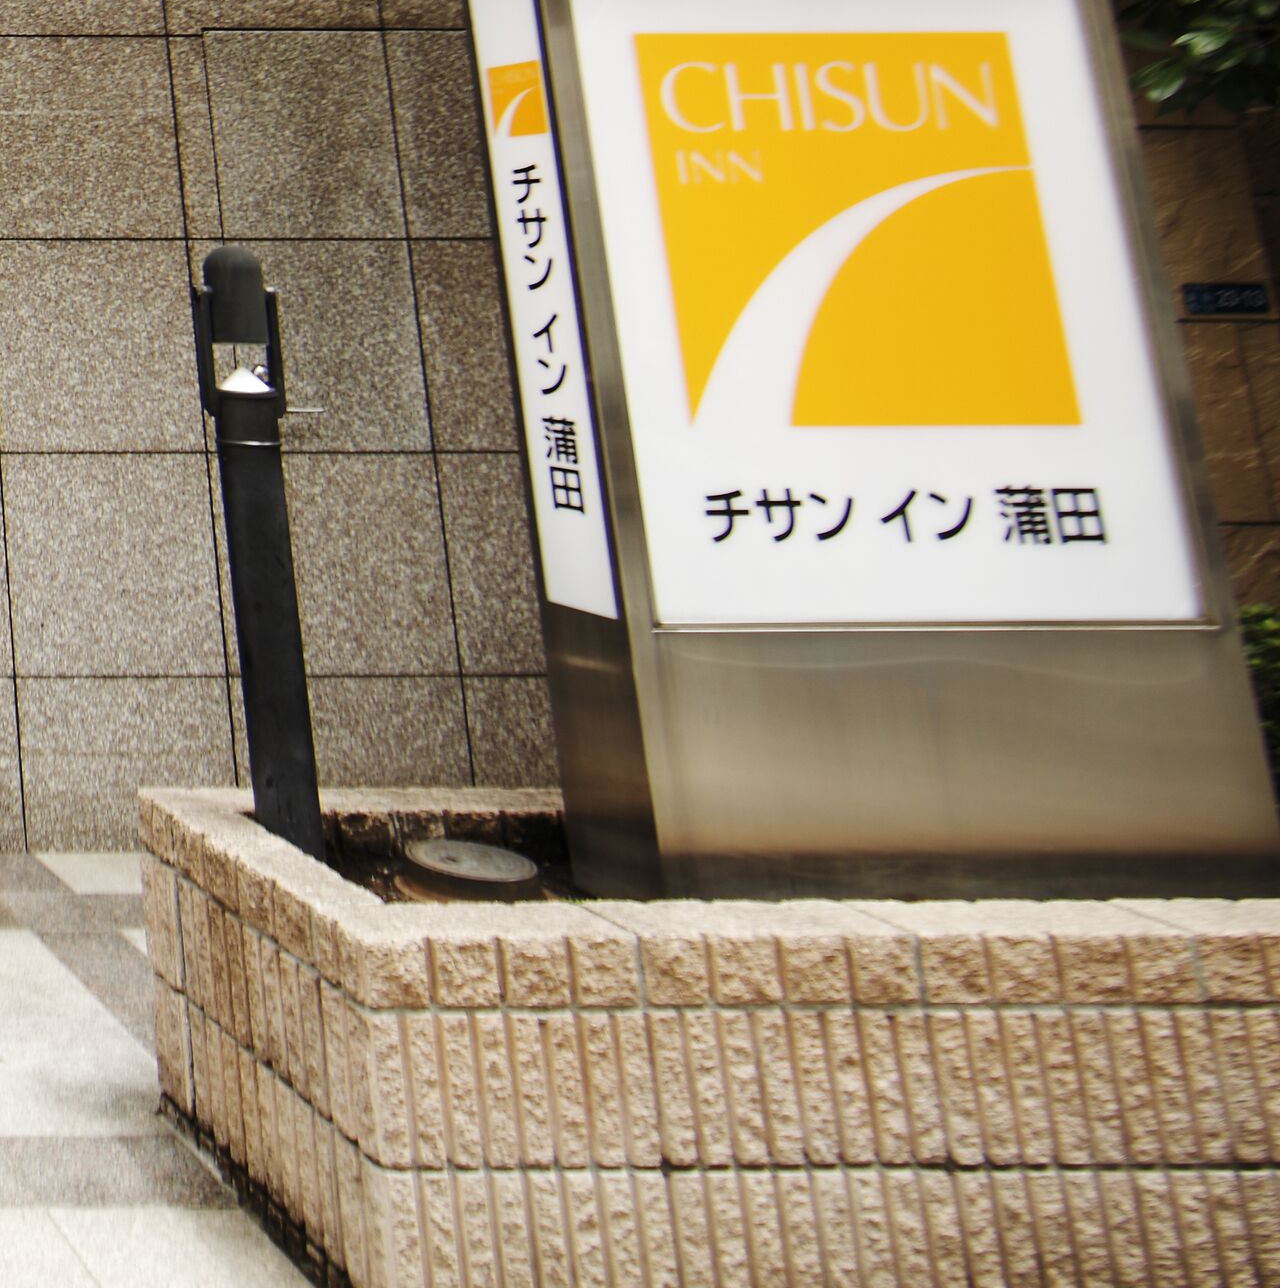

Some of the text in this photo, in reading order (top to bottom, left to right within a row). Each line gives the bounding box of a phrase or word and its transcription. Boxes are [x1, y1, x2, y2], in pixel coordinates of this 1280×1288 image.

[660, 60, 1001, 134] CHISUN
[675, 150, 763, 185] INN
[510, 163, 585, 515] チサン イン 蒲田
[704, 486, 1108, 546] チサン イン 蒲田
